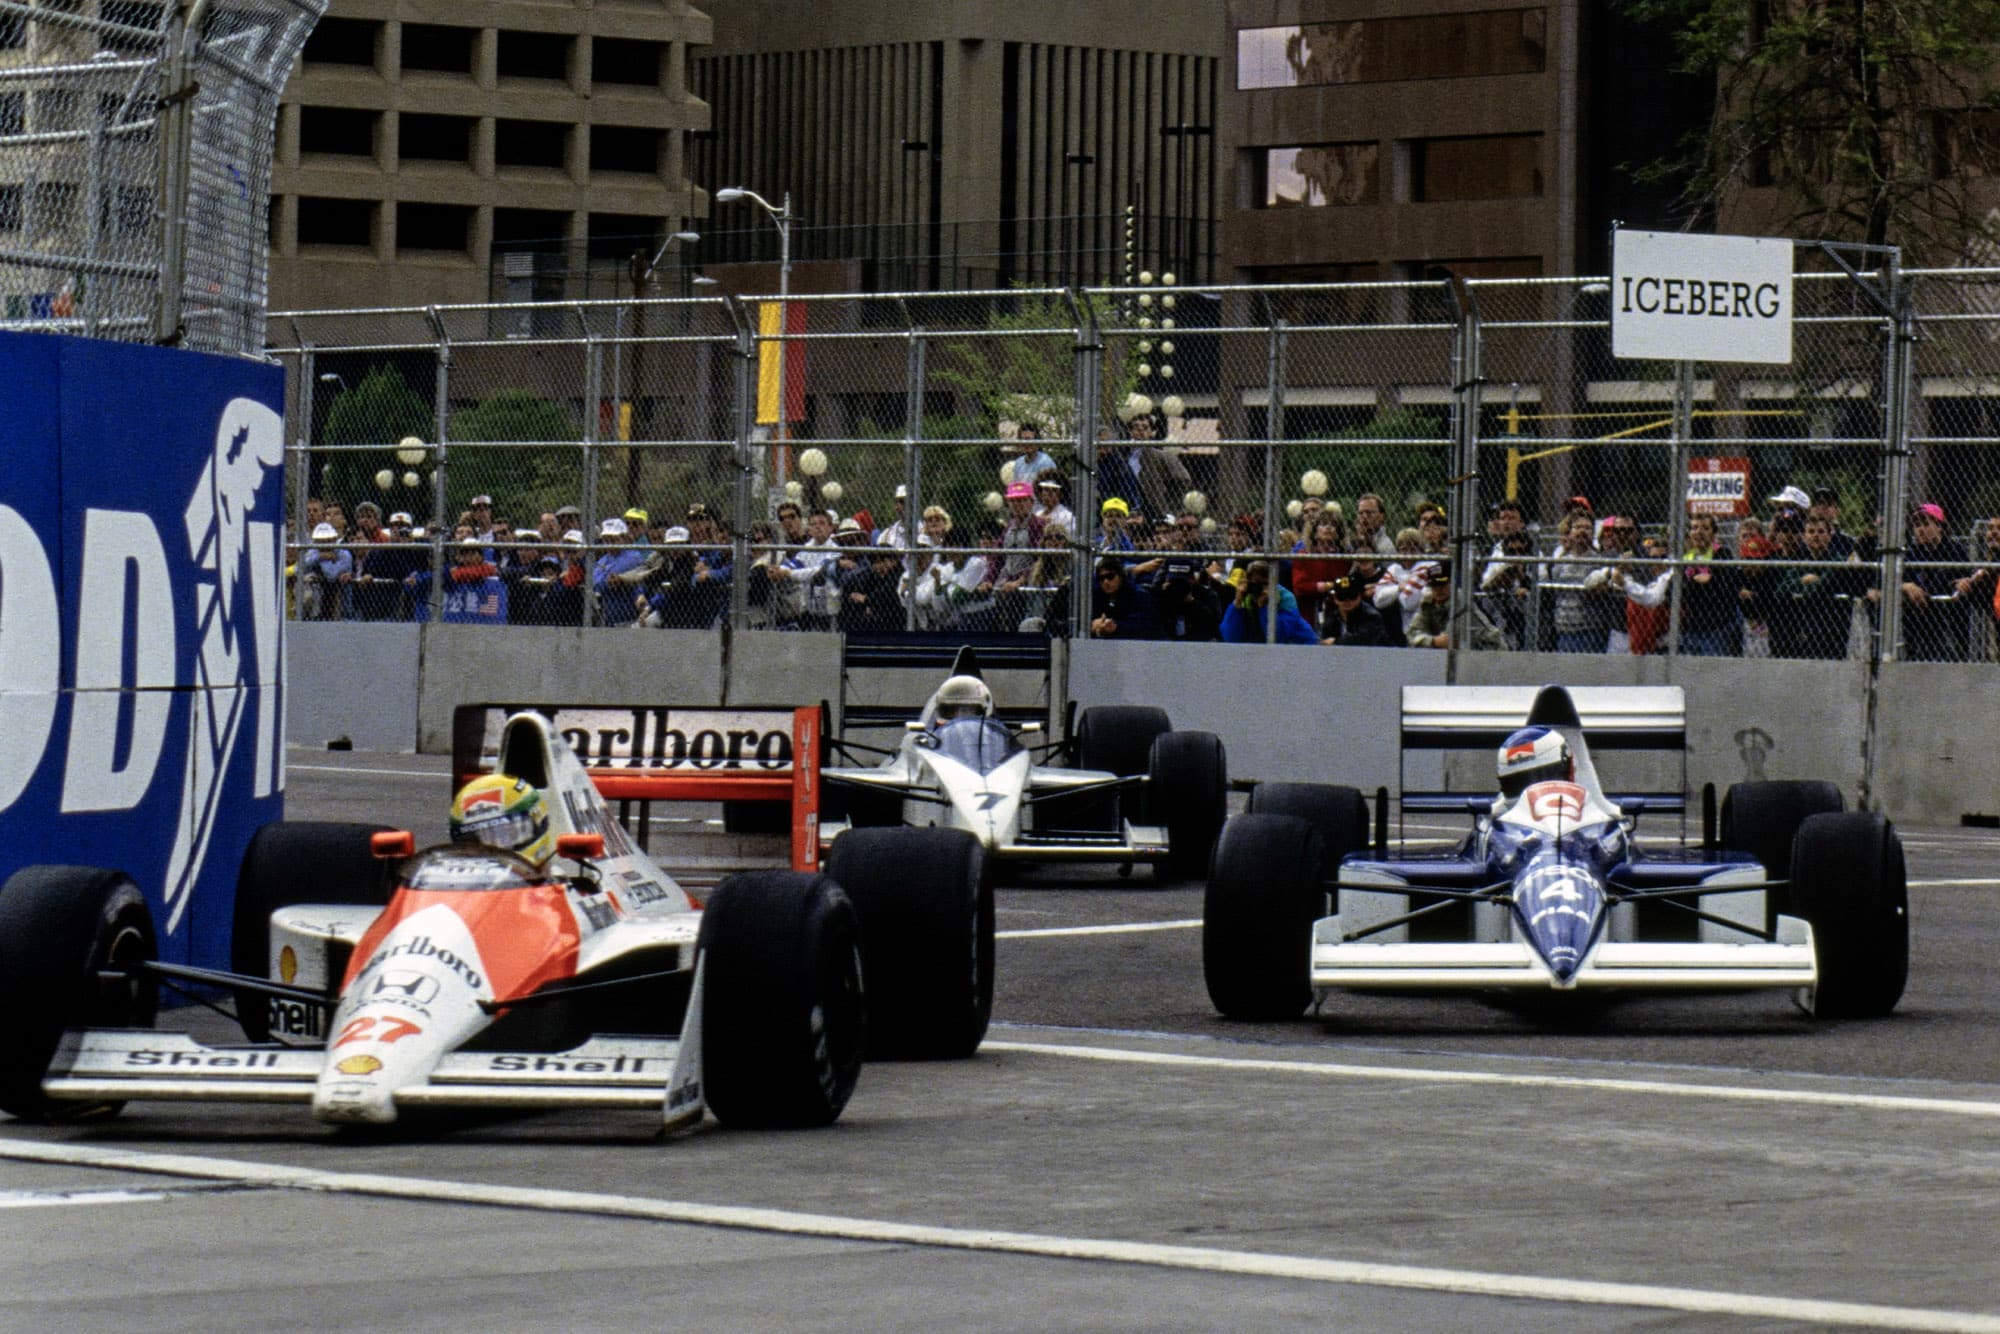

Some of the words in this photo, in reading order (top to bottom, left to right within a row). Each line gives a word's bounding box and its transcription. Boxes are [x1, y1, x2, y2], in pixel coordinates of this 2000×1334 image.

[1621, 276, 1780, 319] ICEBERG
[974, 790, 1009, 811] 7
[1539, 879, 1583, 900] 4
[332, 1014, 423, 1051] 27
[125, 1050, 280, 1068] Shell
[488, 1055, 646, 1073] Shell
